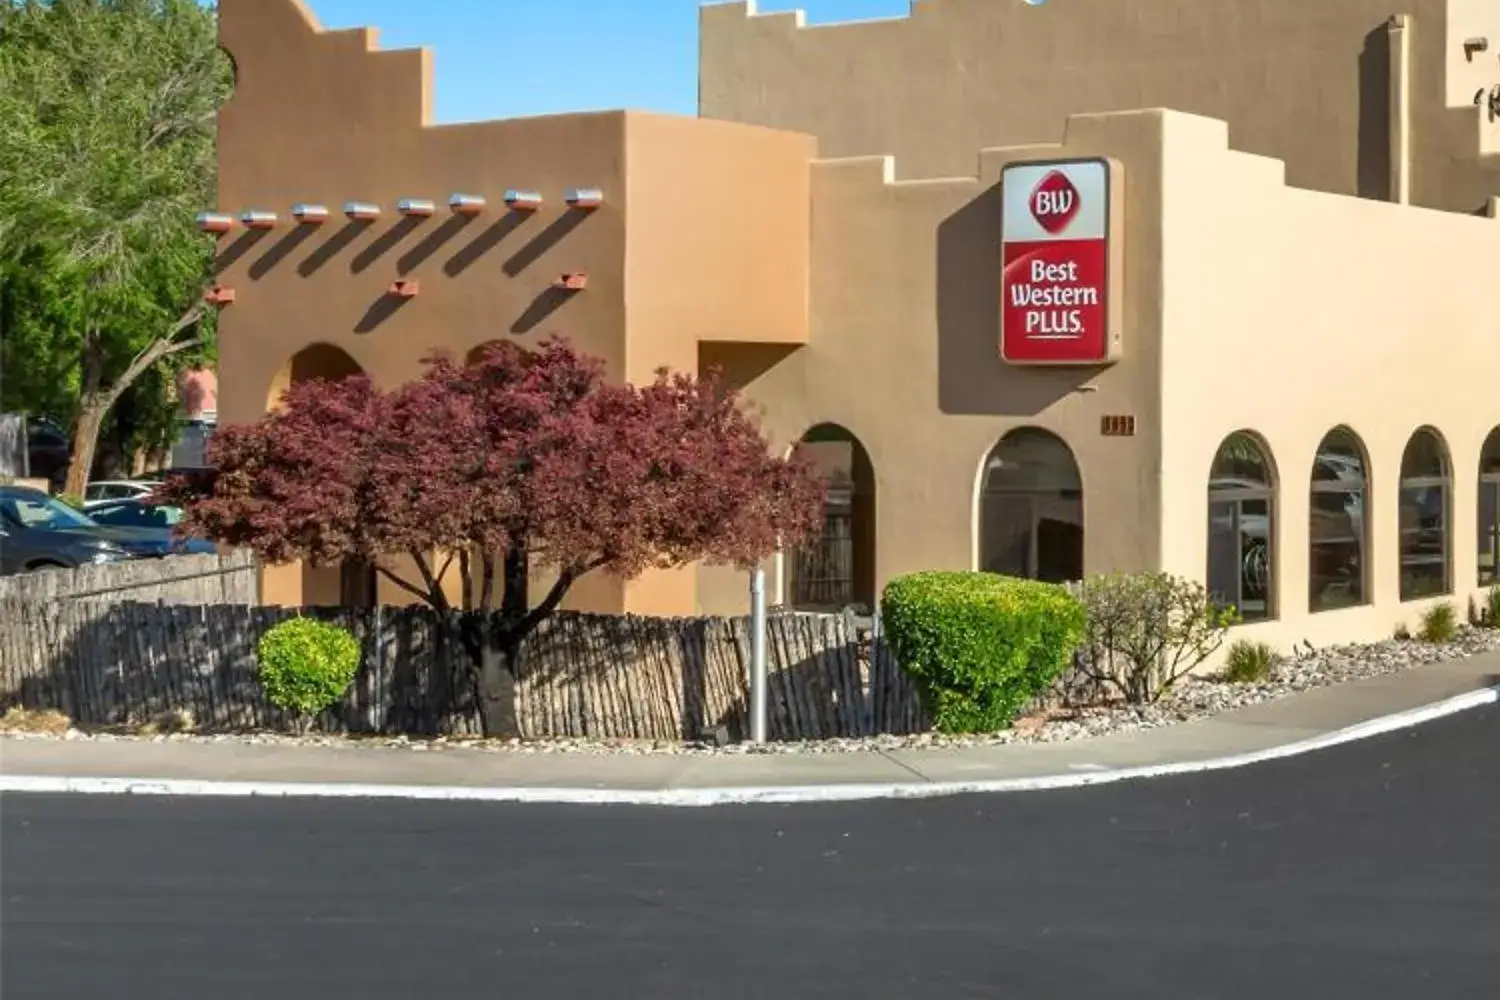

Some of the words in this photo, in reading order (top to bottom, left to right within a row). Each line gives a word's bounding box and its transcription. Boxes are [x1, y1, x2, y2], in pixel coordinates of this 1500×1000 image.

[1035, 190, 1074, 216] BW
[1031, 259, 1078, 282] Best
[1011, 284, 1099, 307] Western
